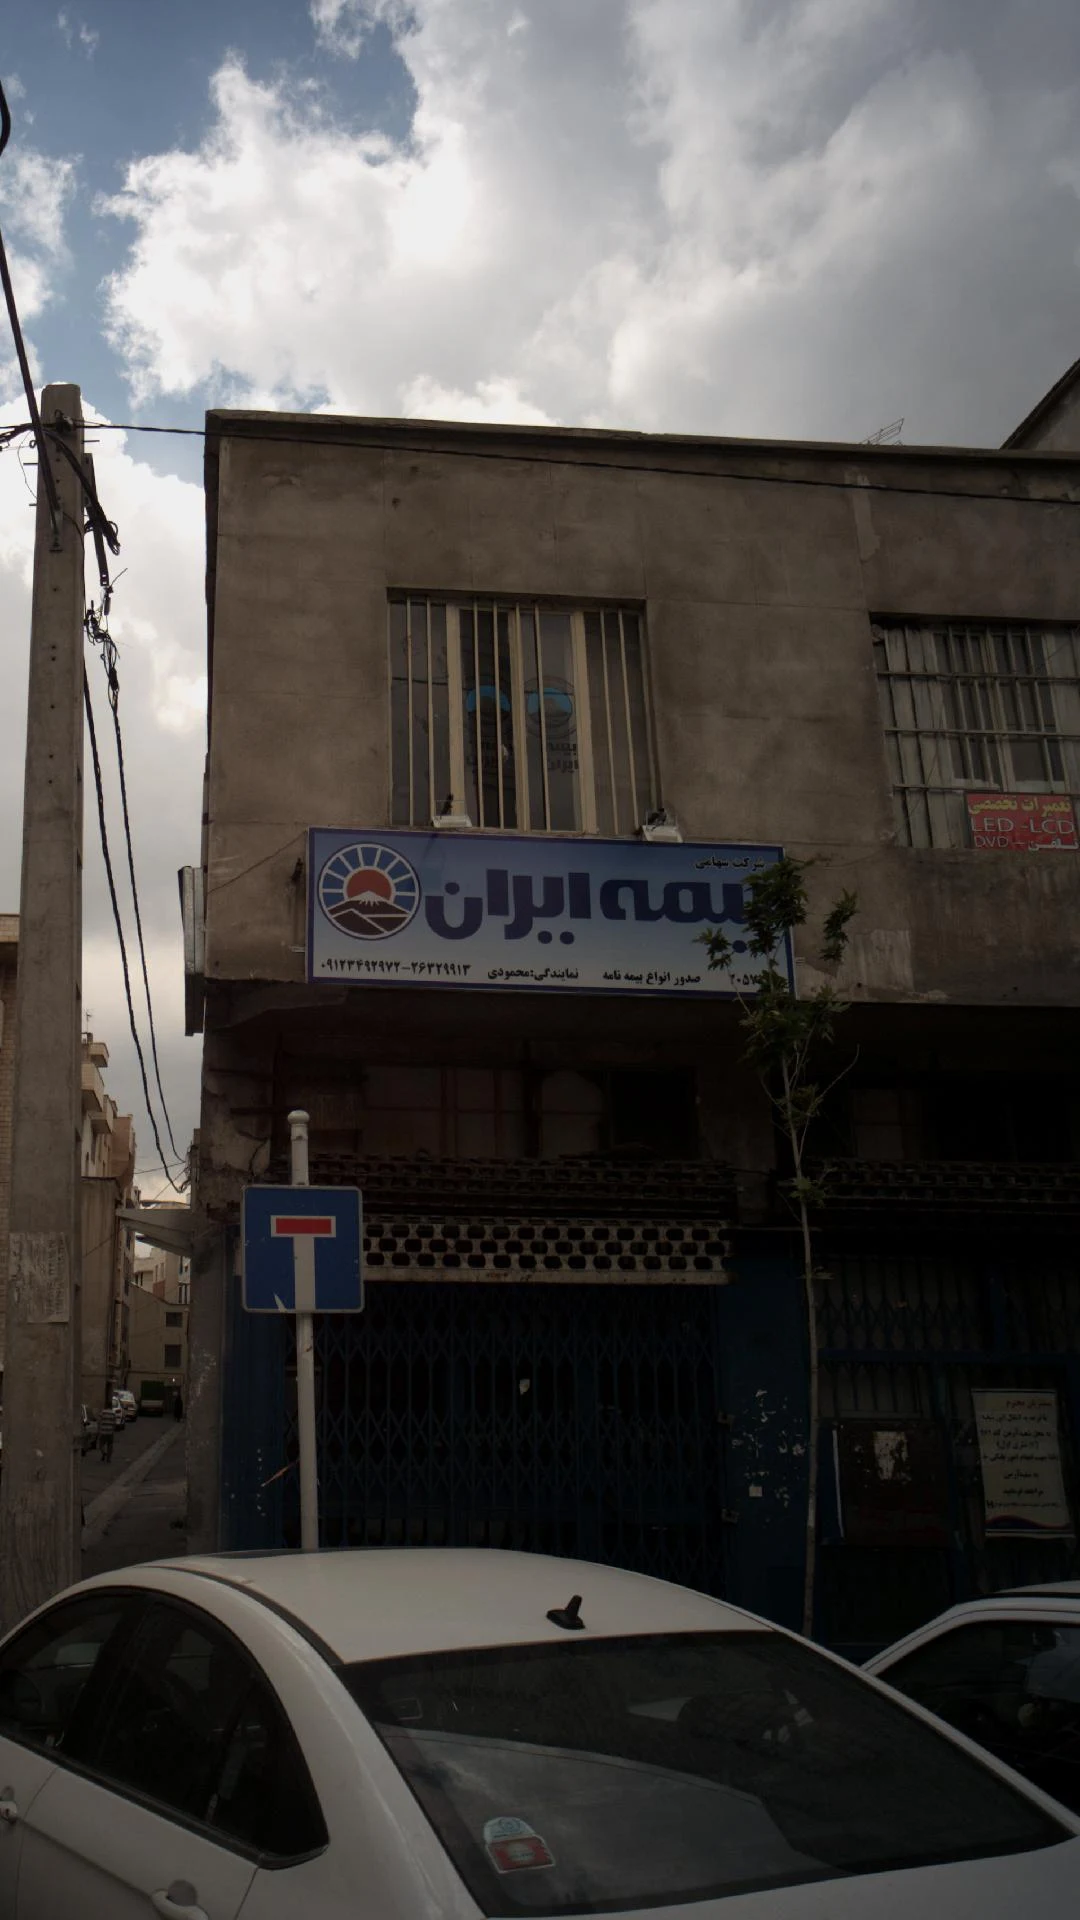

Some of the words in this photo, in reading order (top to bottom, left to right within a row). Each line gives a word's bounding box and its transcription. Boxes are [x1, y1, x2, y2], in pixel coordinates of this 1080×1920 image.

[970, 816, 1014, 832] LED
[973, 835, 1009, 848] DVD
[424, 868, 592, 945] ایران
[602, 969, 622, 981] نامه
[624, 973, 643, 984] بیمه
[646, 971, 671, 985] انواع
[672, 973, 701, 986] صدور
